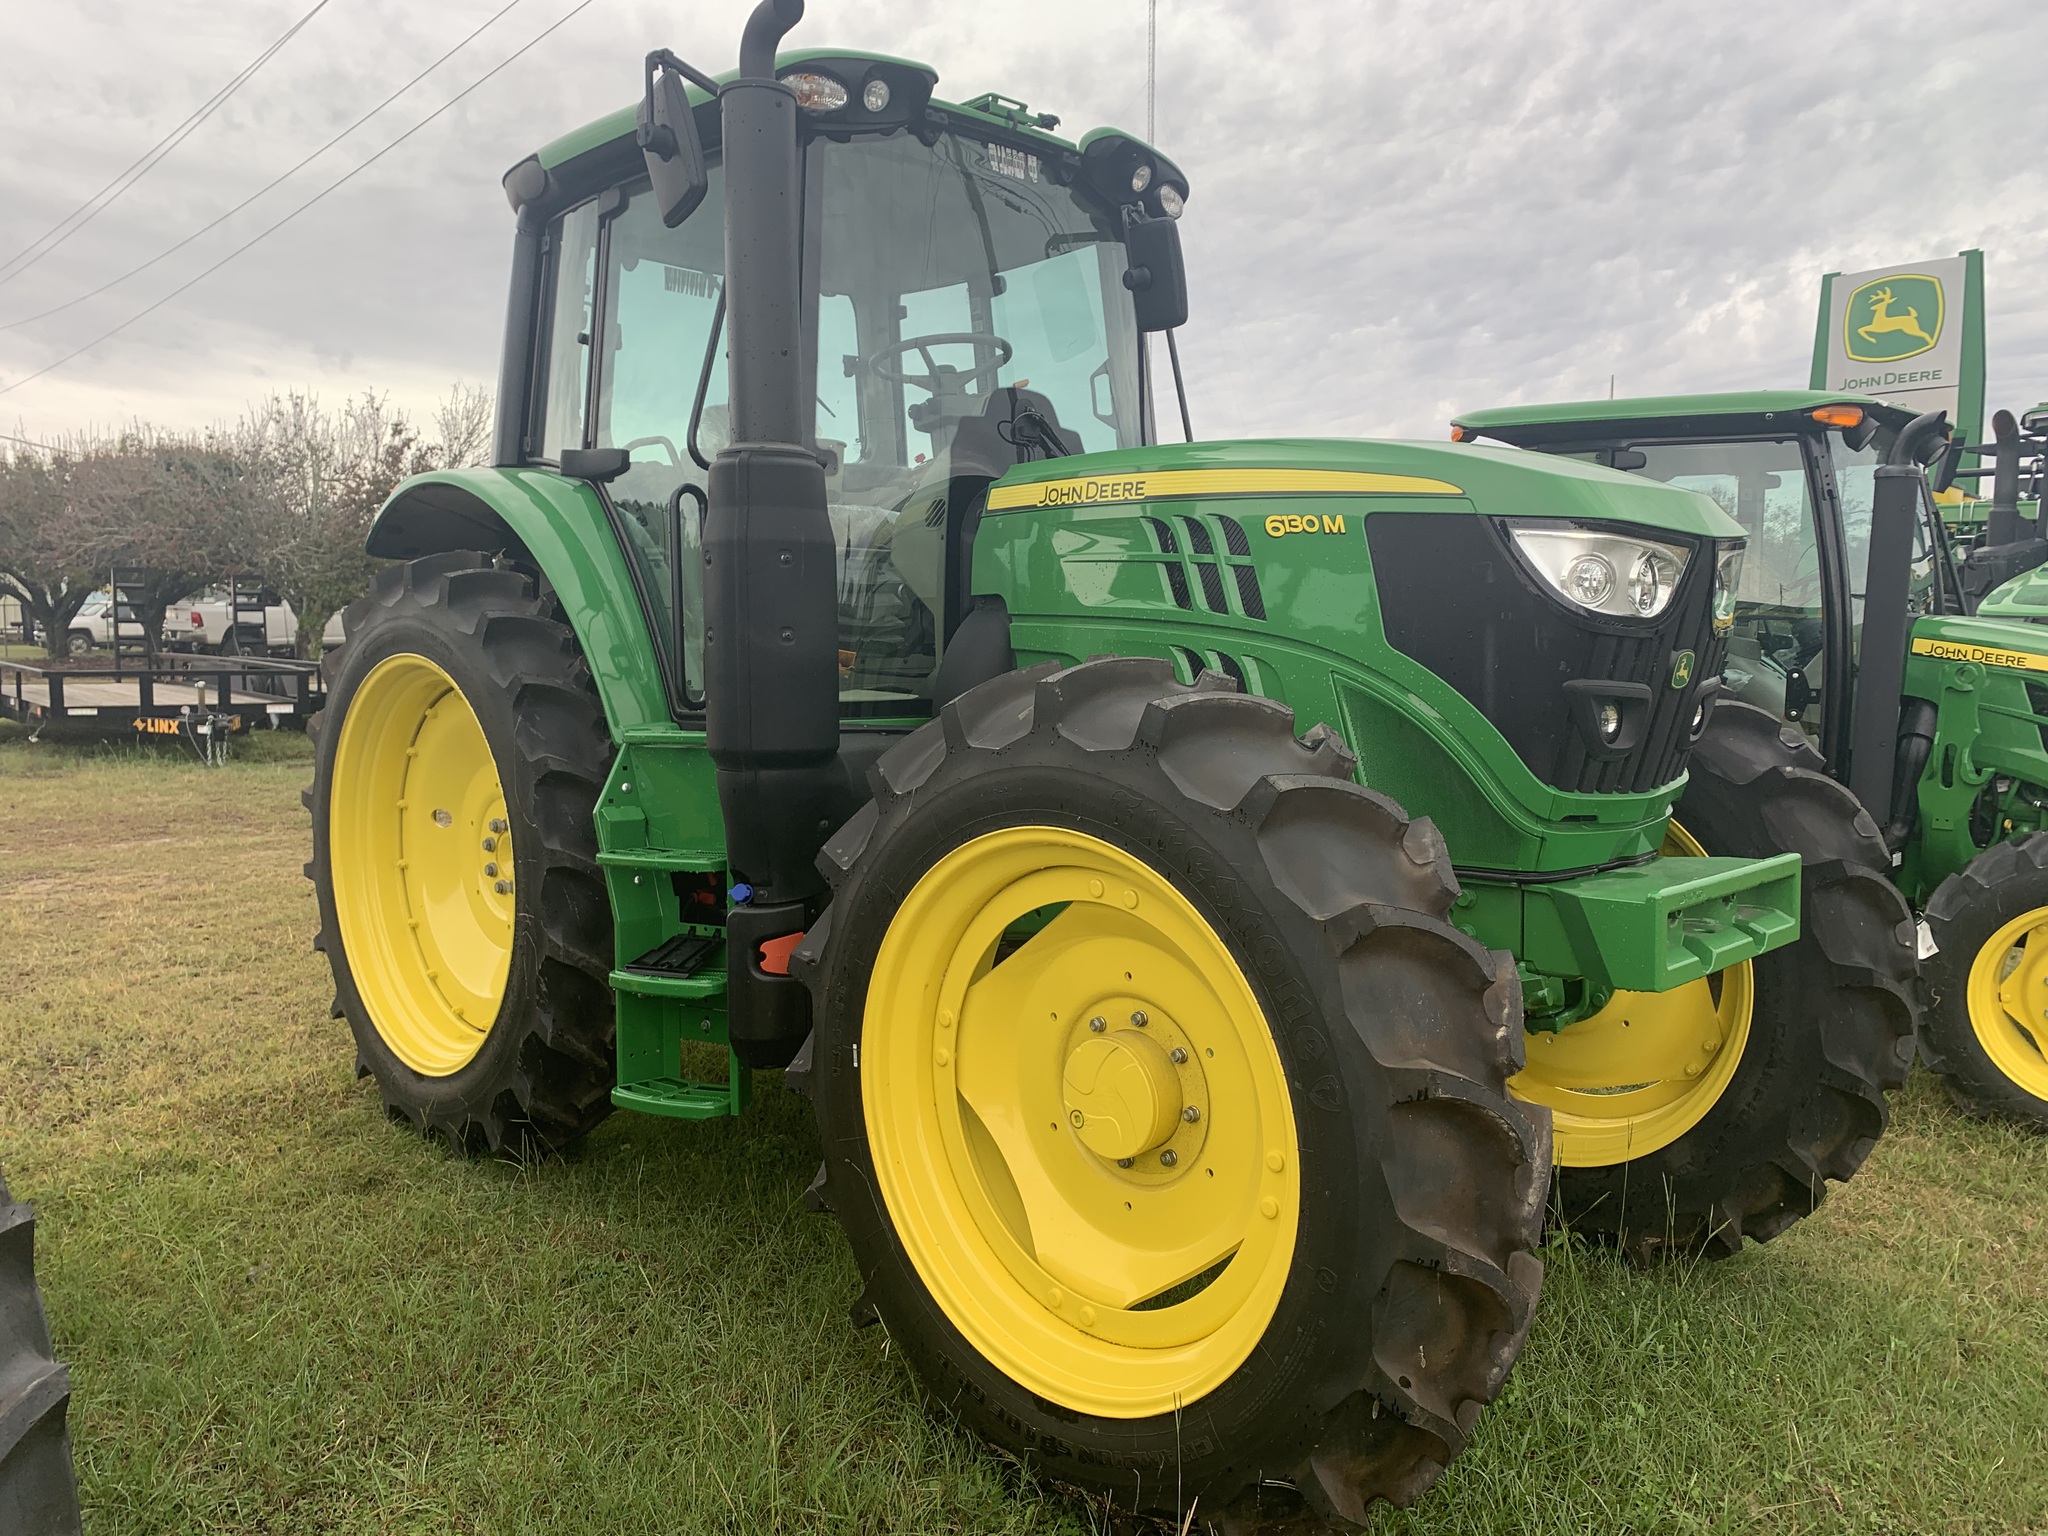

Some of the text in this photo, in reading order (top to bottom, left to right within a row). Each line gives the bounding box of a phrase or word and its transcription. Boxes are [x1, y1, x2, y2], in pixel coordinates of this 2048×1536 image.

[1838, 369, 1943, 391] JOHN DEERE
[1038, 481, 1146, 504] JOHN DEERE
[1924, 643, 2028, 667] JOHN DEERE
[147, 718, 180, 735] LINX
